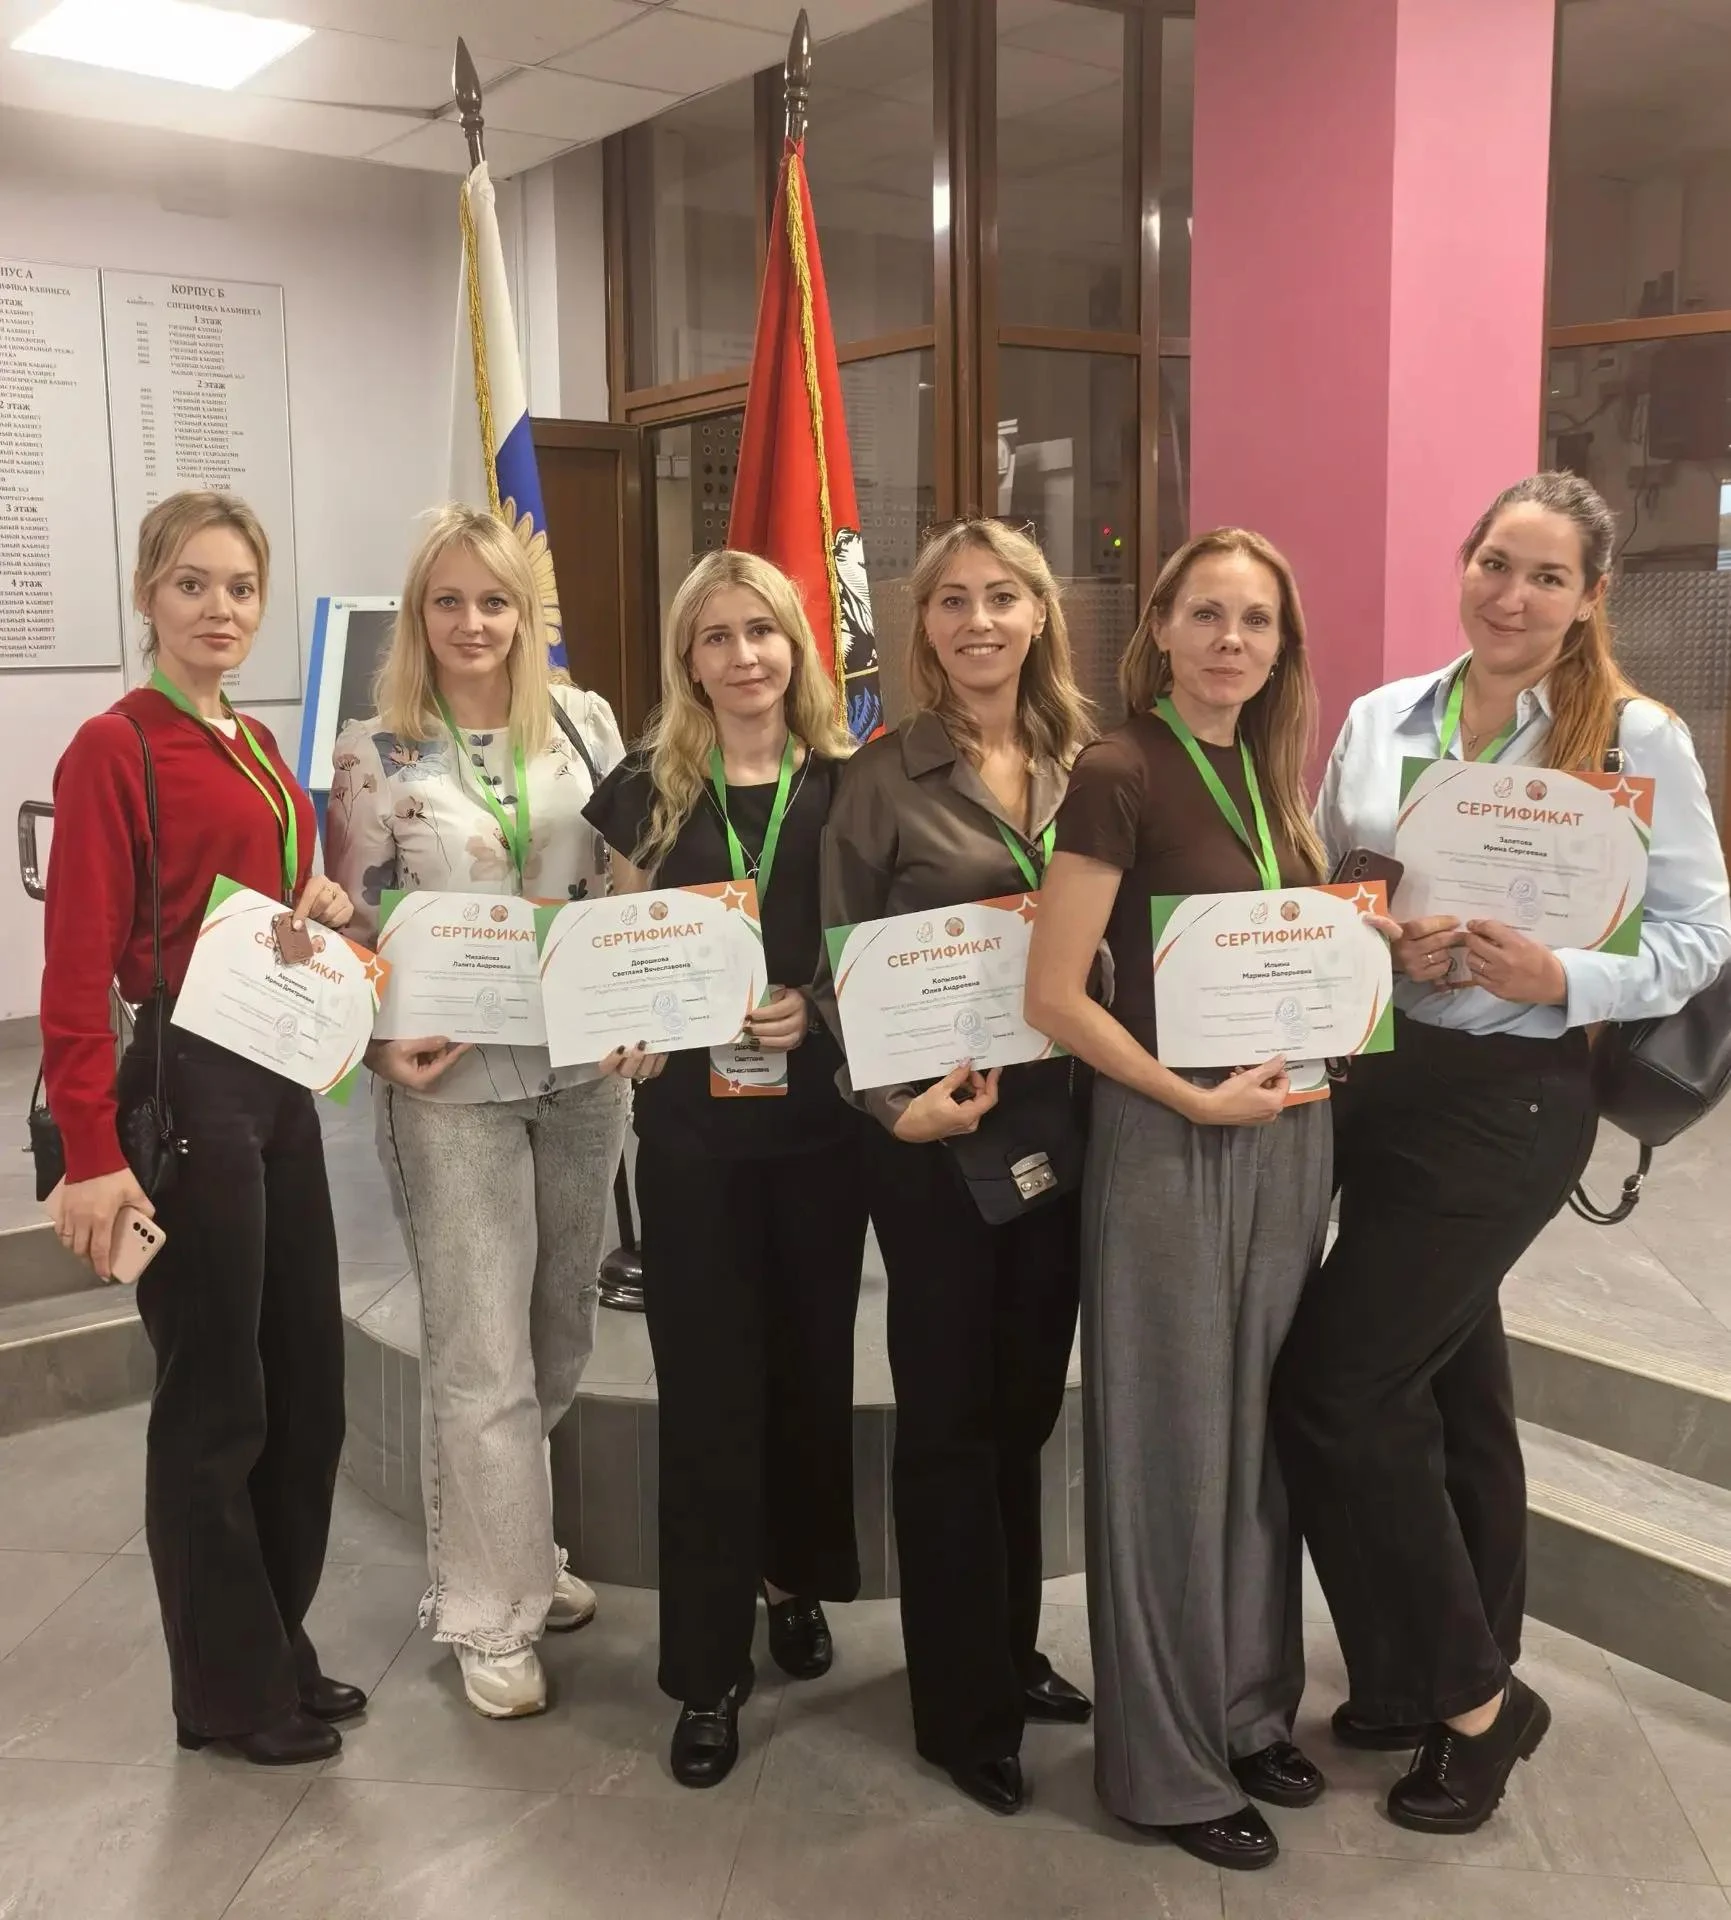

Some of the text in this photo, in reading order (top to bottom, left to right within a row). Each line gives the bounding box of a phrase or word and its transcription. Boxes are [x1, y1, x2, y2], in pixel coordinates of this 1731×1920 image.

[171, 284, 226, 298] КОРПУС Б
[166, 301, 262, 316] СПЕЦИФИКА КАБИНЕТА
[194, 316, 223, 326] 1 этаж
[197, 380, 202, 388] 2
[6, 504, 12, 512] 3
[11, 578, 16, 587] 4
[1456, 800, 1584, 826] СЕРТИФИКАТ
[431, 926, 536, 942] СЕРТИФИКАТ
[592, 922, 704, 948] СЕРТИФИКАТ
[1215, 925, 1335, 948] СЕРТИФИКАТ
[886, 936, 1002, 968] СЕРТИФИКАТ
[612, 962, 691, 978] Светлана Вячеславовна
[1242, 968, 1312, 980] Марина Валерьевна
[932, 974, 967, 984] Копылова
[922, 980, 980, 996] Юлия Андреевна
